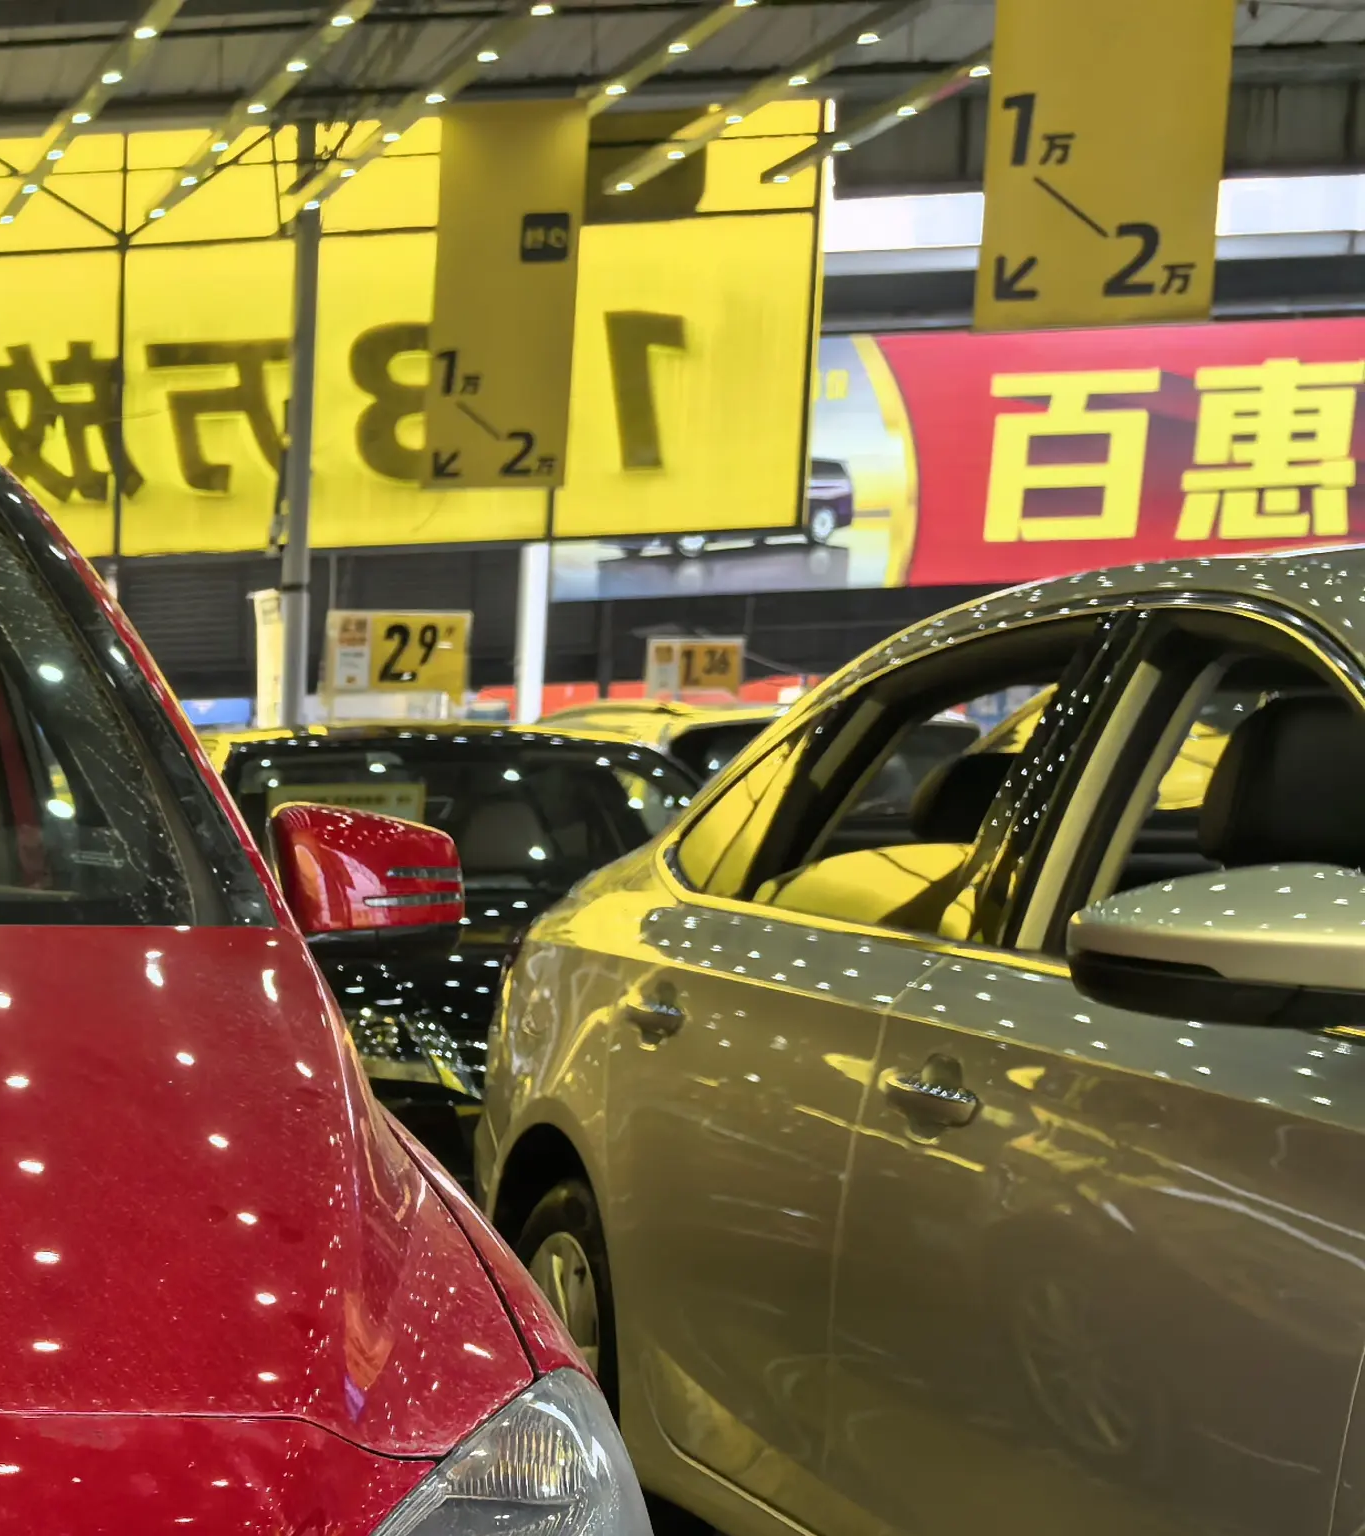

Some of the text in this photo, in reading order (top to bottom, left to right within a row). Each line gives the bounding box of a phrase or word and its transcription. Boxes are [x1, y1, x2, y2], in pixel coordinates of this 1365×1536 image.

[1002, 92, 1076, 167] 1万
[1102, 222, 1197, 297] 2万
[435, 350, 481, 395] 1万
[501, 432, 556, 476] 2万
[983, 358, 1365, 543] 百惠
